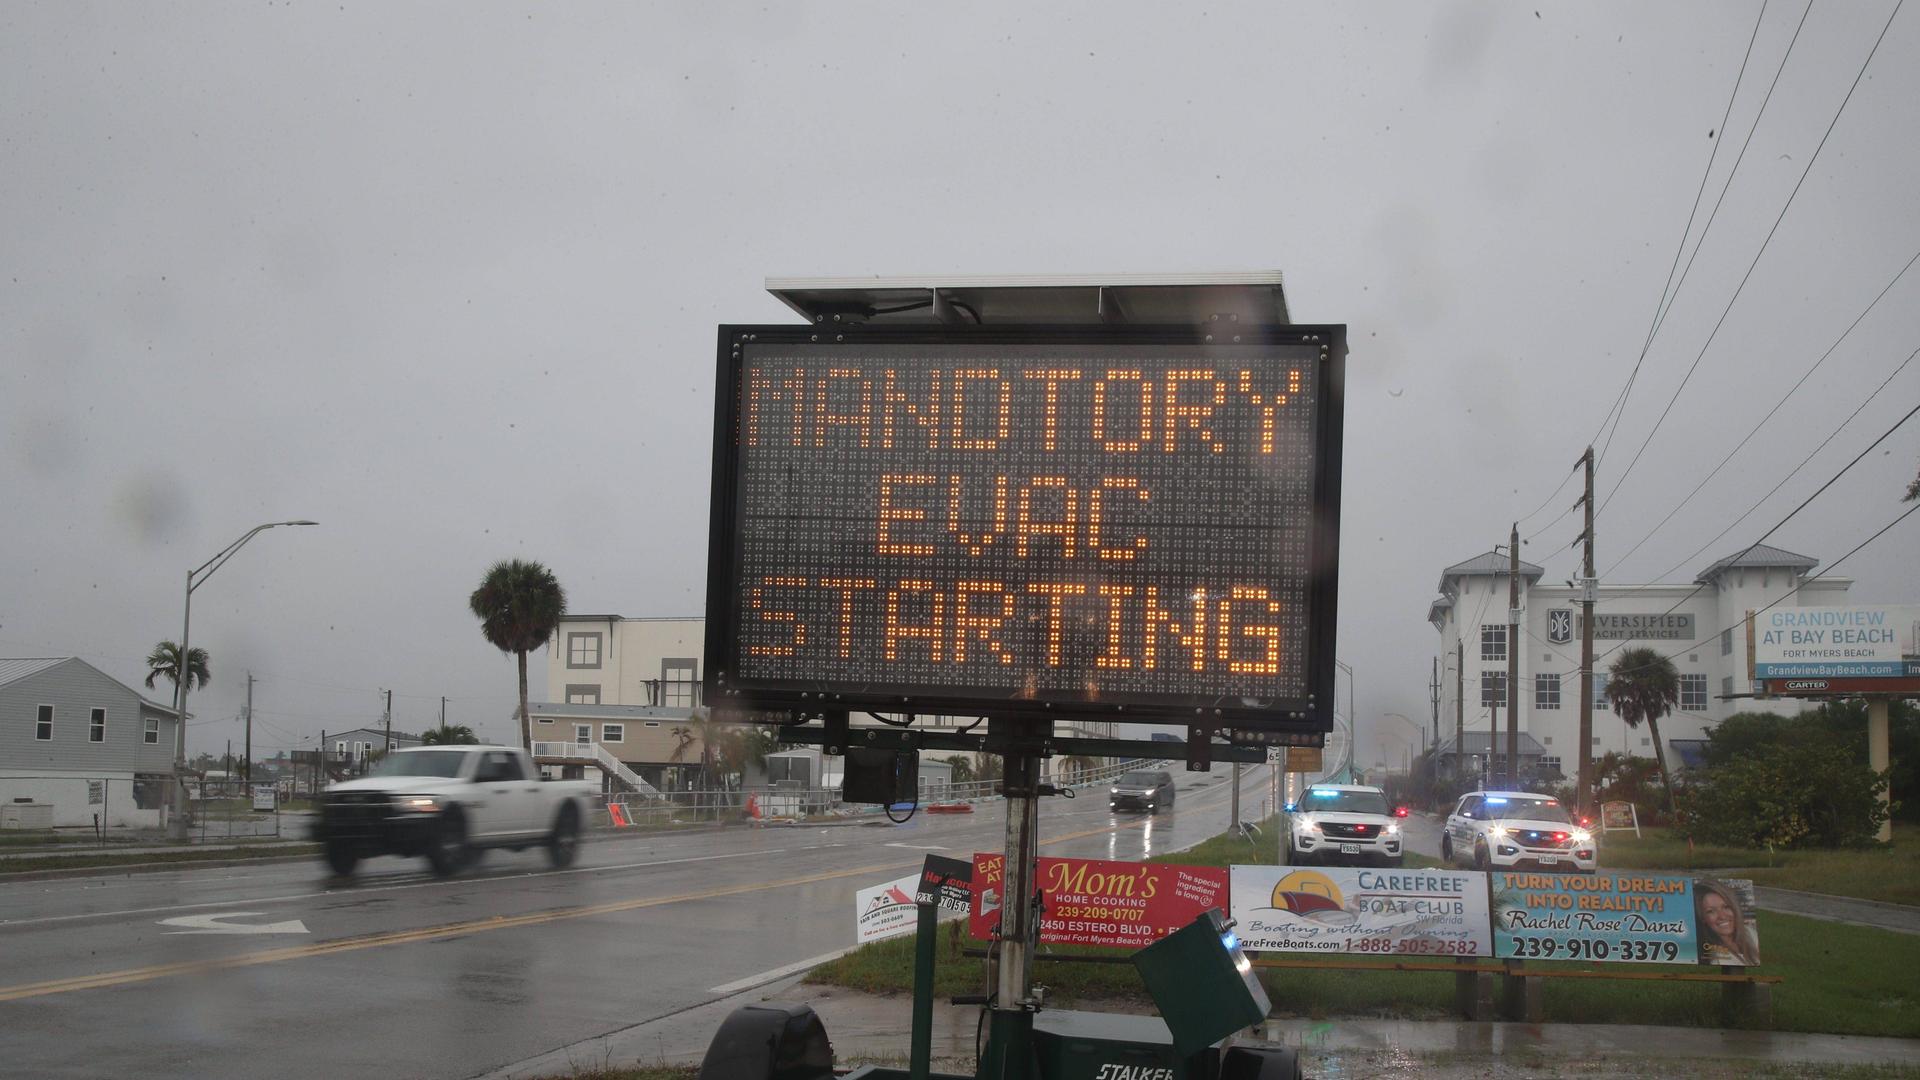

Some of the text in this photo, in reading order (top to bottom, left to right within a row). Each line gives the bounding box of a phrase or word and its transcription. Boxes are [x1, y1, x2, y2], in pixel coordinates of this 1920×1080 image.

[748, 367, 1300, 455] MANDTORY
[878, 472, 1149, 559] EVAC
[749, 576, 1280, 675] STARTING
[1580, 615, 1689, 628] IVERSIFIED
[1772, 611, 1885, 627] GRANDVIEW
[1594, 630, 1680, 638] ACHT SERVICES
[1763, 629, 1893, 645] AT BAY BEACH
[1783, 649, 1875, 658] FORT MYERS BEACH
[1767, 665, 1892, 676] GrandviewBayBeach.com
[1269, 752, 1280, 761] 65
[978, 857, 1002, 874] EAT
[987, 869, 1001, 884] AT
[1045, 862, 1159, 898] Mom's
[1178, 871, 1221, 889] The special
[1358, 871, 1463, 892] CAREFREE
[1503, 873, 1685, 895] TURN YOUR DREAM
[1175, 888, 1200, 901] is love
[1177, 880, 1216, 896] ingredient
[1056, 894, 1147, 908] HOME COOKING
[1360, 900, 1464, 915] BOAT CLUB
[1526, 893, 1663, 912] INTO REALITY!
[1057, 906, 1145, 921] 239-209-0707
[1432, 915, 1463, 925] Florida
[1040, 920, 1065, 931] 2450
[1068, 921, 1117, 934] ESTERO
[1120, 924, 1154, 936] BLVD.
[1248, 920, 1319, 939] Boating
[1506, 911, 1686, 933] Rachel Rose Danzi
[1040, 933, 1071, 943] original
[1073, 935, 1089, 943] Fort
[1091, 936, 1114, 946] Myers
[1116, 937, 1142, 946] Beach
[1345, 938, 1477, 955] 1-888-505-2582
[1512, 937, 1680, 961] 239-910-3379
